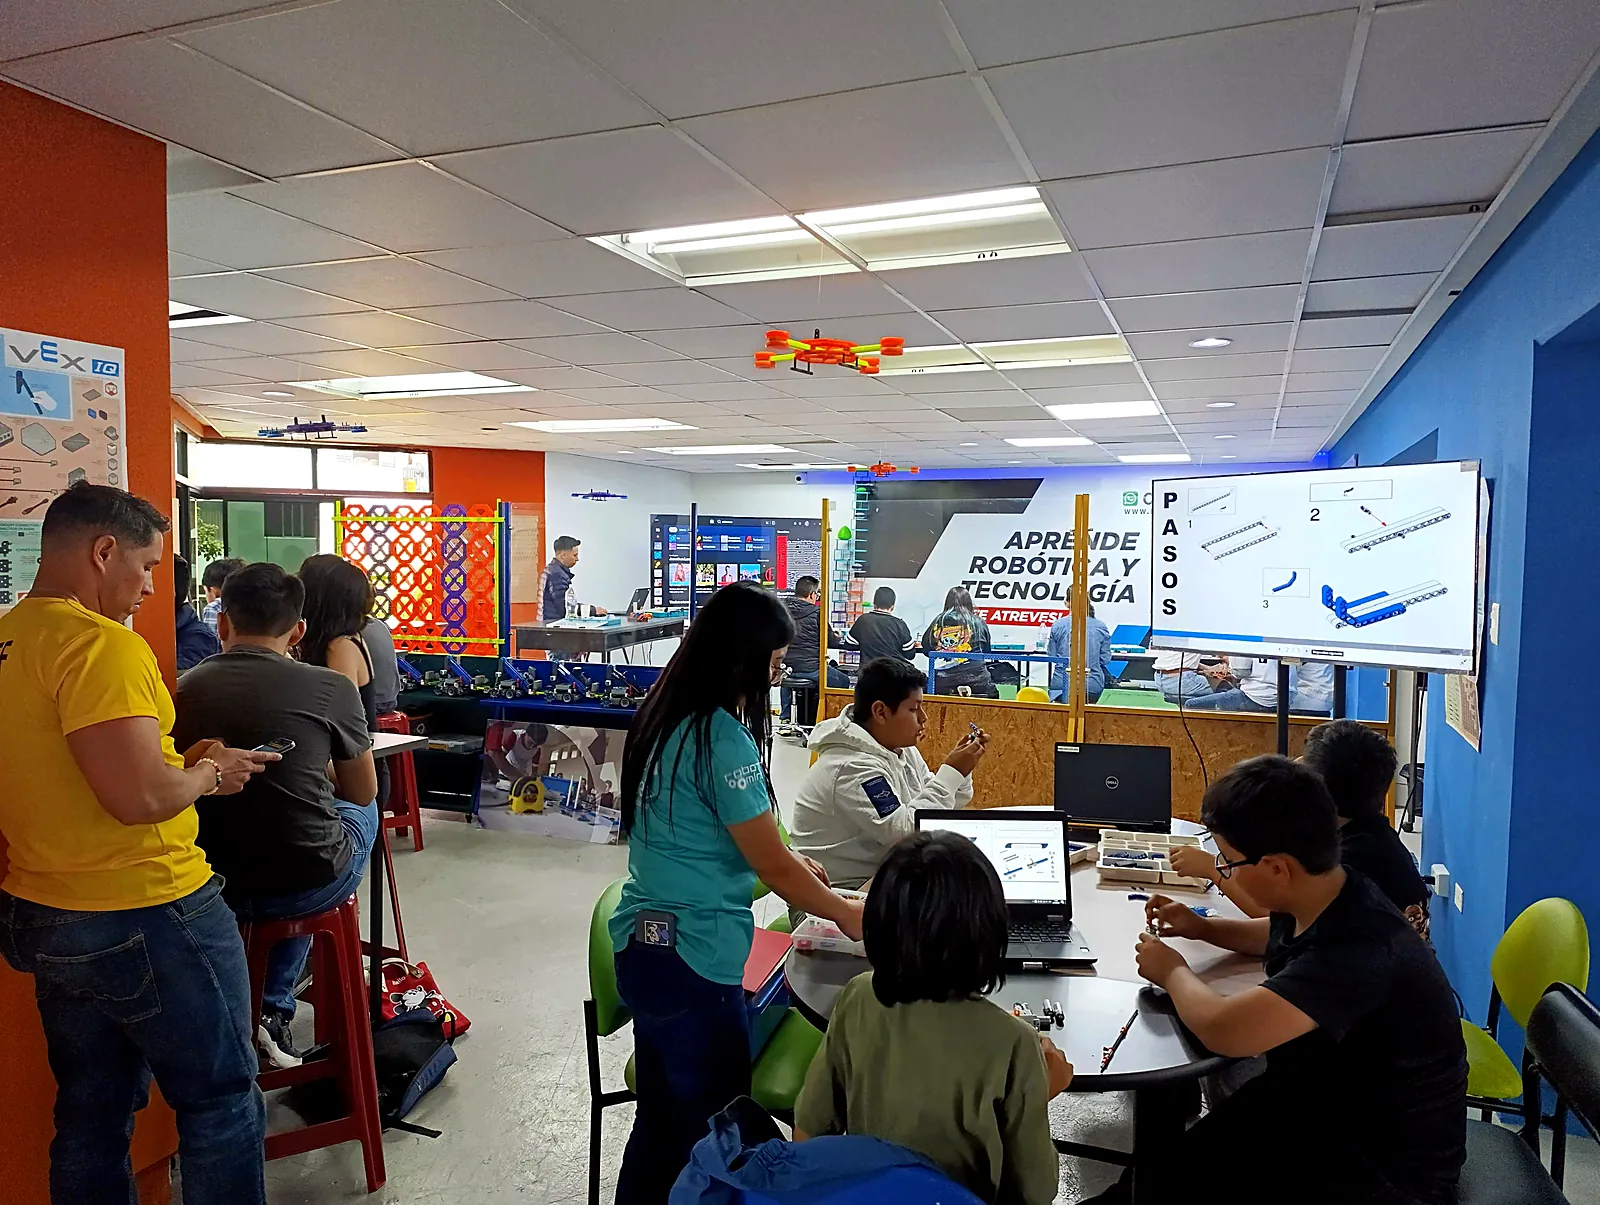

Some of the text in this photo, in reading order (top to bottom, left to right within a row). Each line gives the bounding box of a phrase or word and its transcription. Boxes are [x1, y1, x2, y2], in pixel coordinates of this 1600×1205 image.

[9, 341, 117, 374] VEX IQ
[1188, 520, 1192, 528] 1
[1310, 508, 1320, 521] 2
[1003, 531, 1140, 551] APRENDE
[968, 552, 1141, 577] ROBÓTIA Y
[1162, 492, 1179, 615] PASOS
[961, 579, 1135, 604] TECNOLGÍA
[1262, 600, 1269, 608] 3
